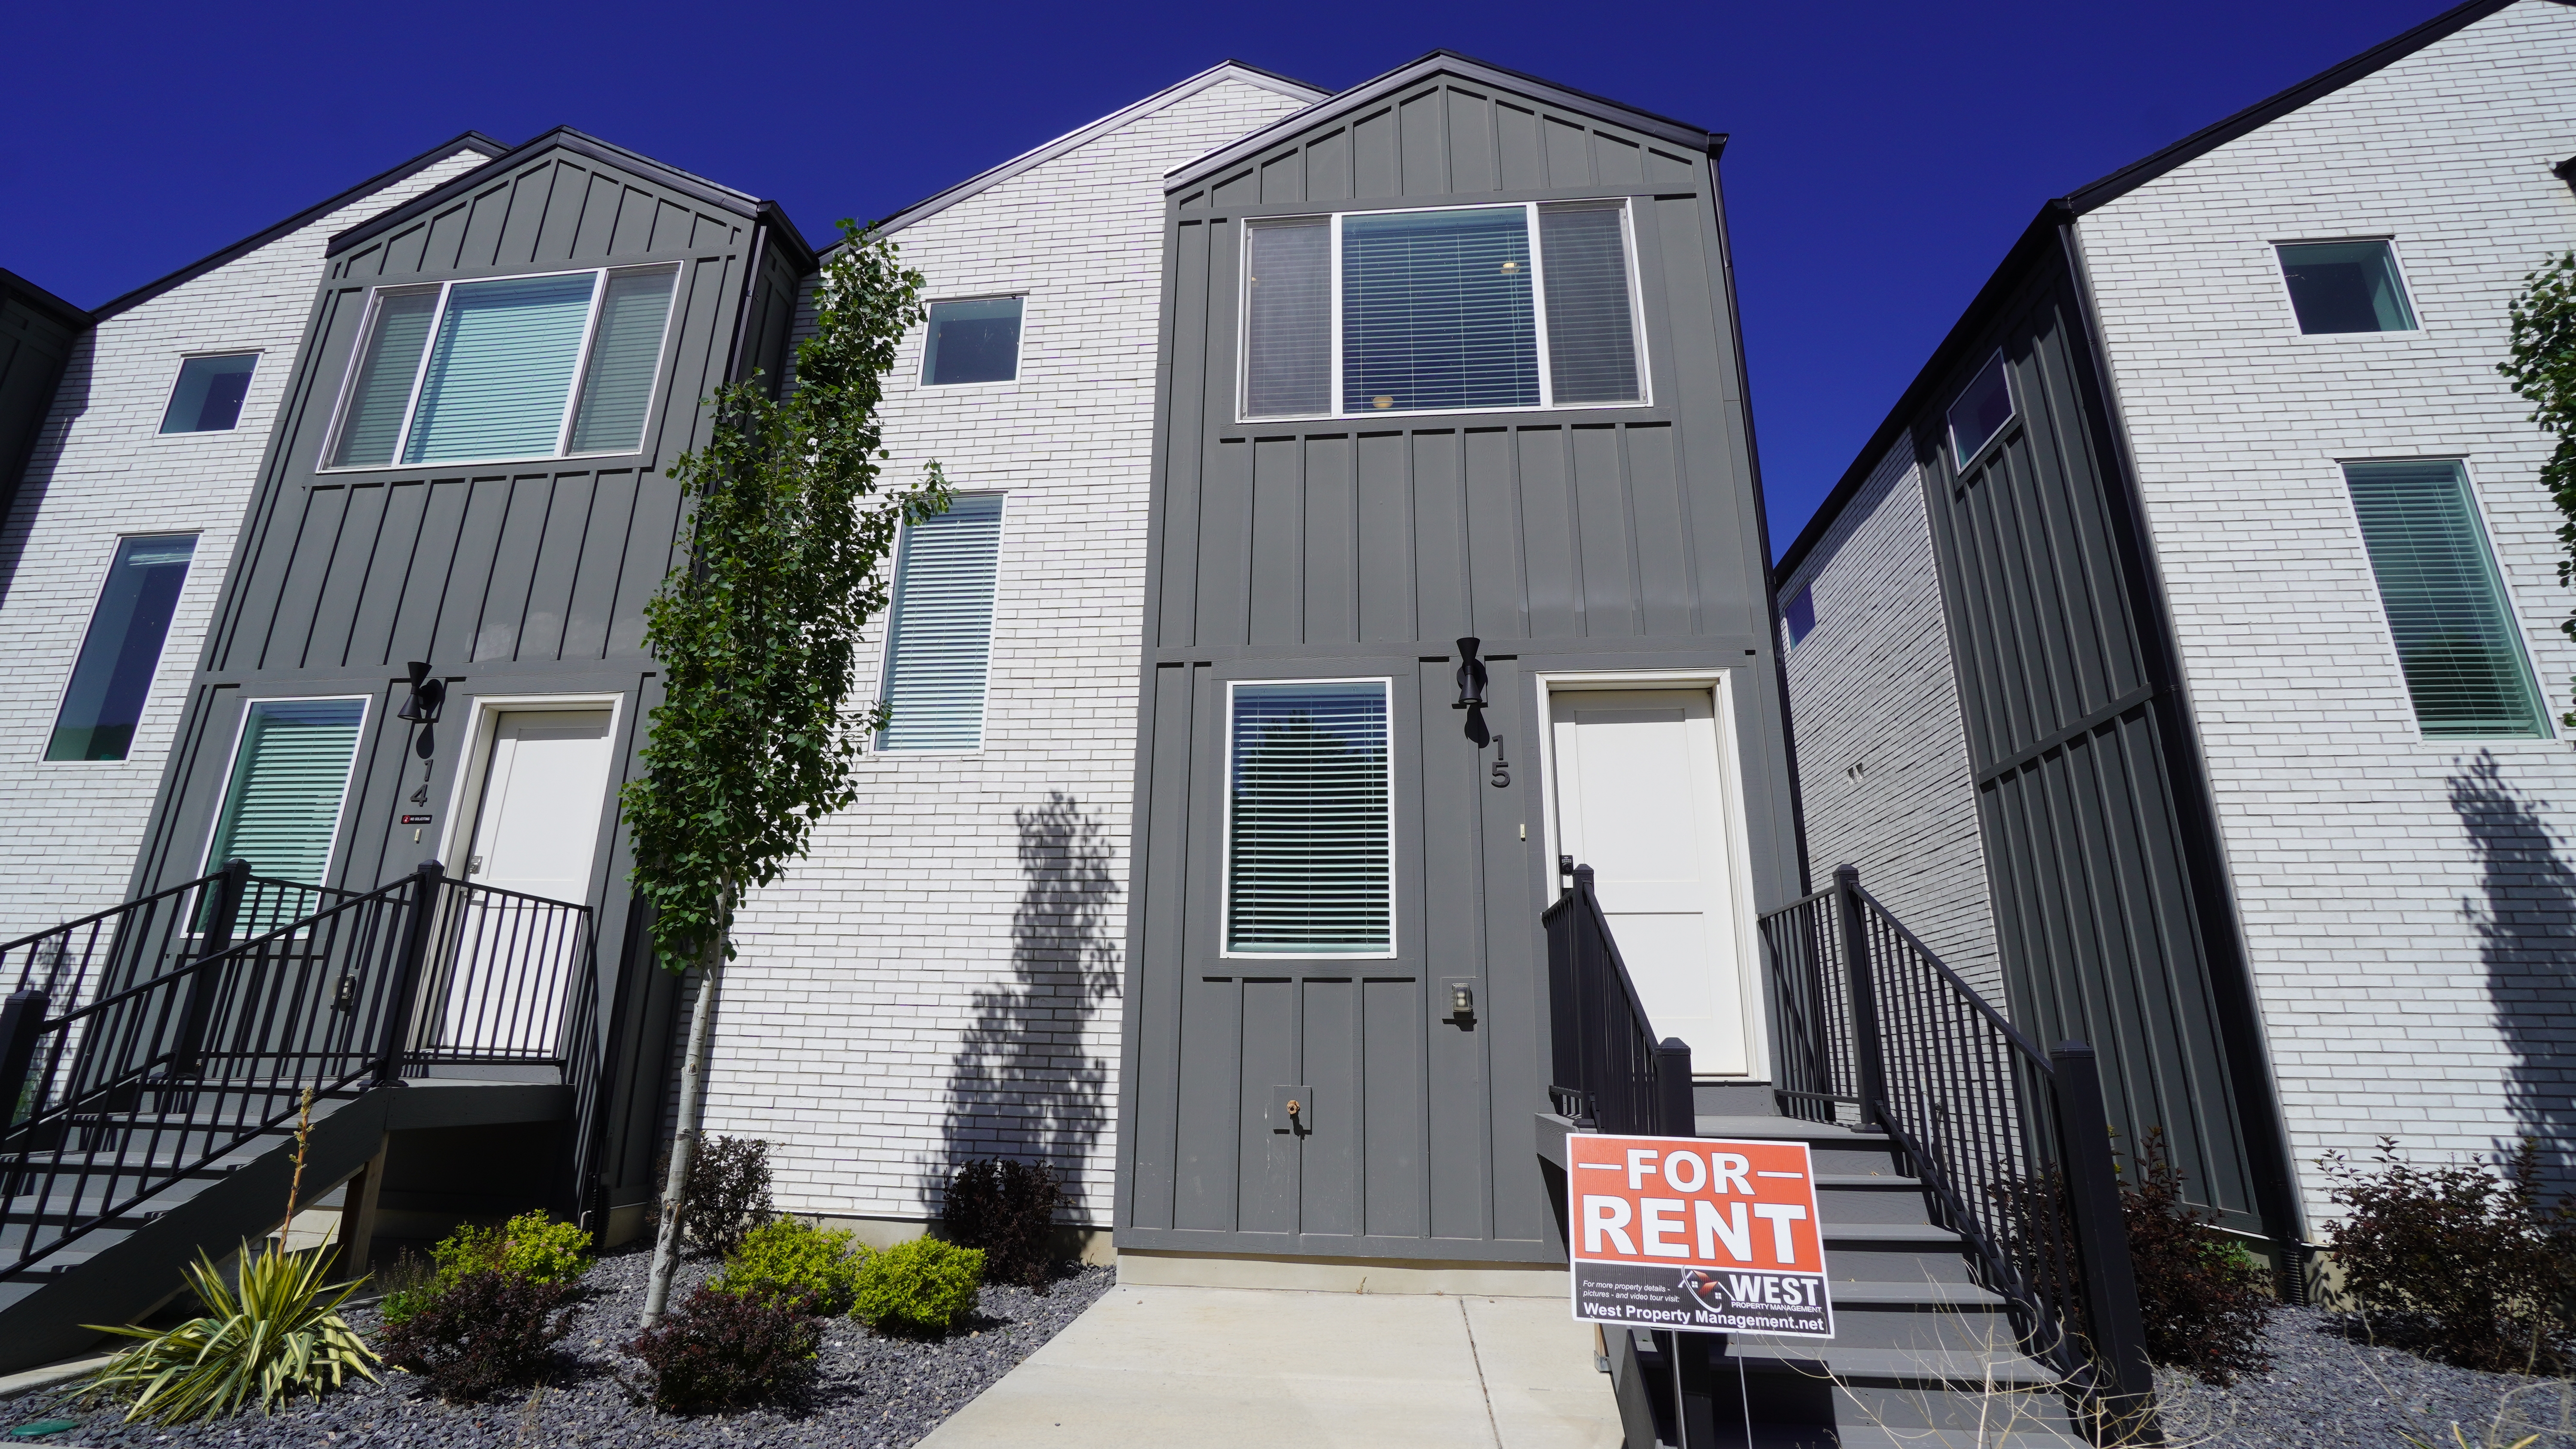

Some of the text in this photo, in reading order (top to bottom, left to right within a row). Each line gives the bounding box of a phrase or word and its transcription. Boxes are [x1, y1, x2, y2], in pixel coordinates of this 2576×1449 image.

[1627, 1148, 1756, 1195] FOR
[1583, 1194, 1807, 1264] RENT
[1615, 1283, 1642, 1291] property
[1728, 1274, 1819, 1306] WEST
[1583, 1302, 1824, 1331] West Property Management.net
[1731, 1301, 1822, 1313] PROPERTY MANAGEMENT
